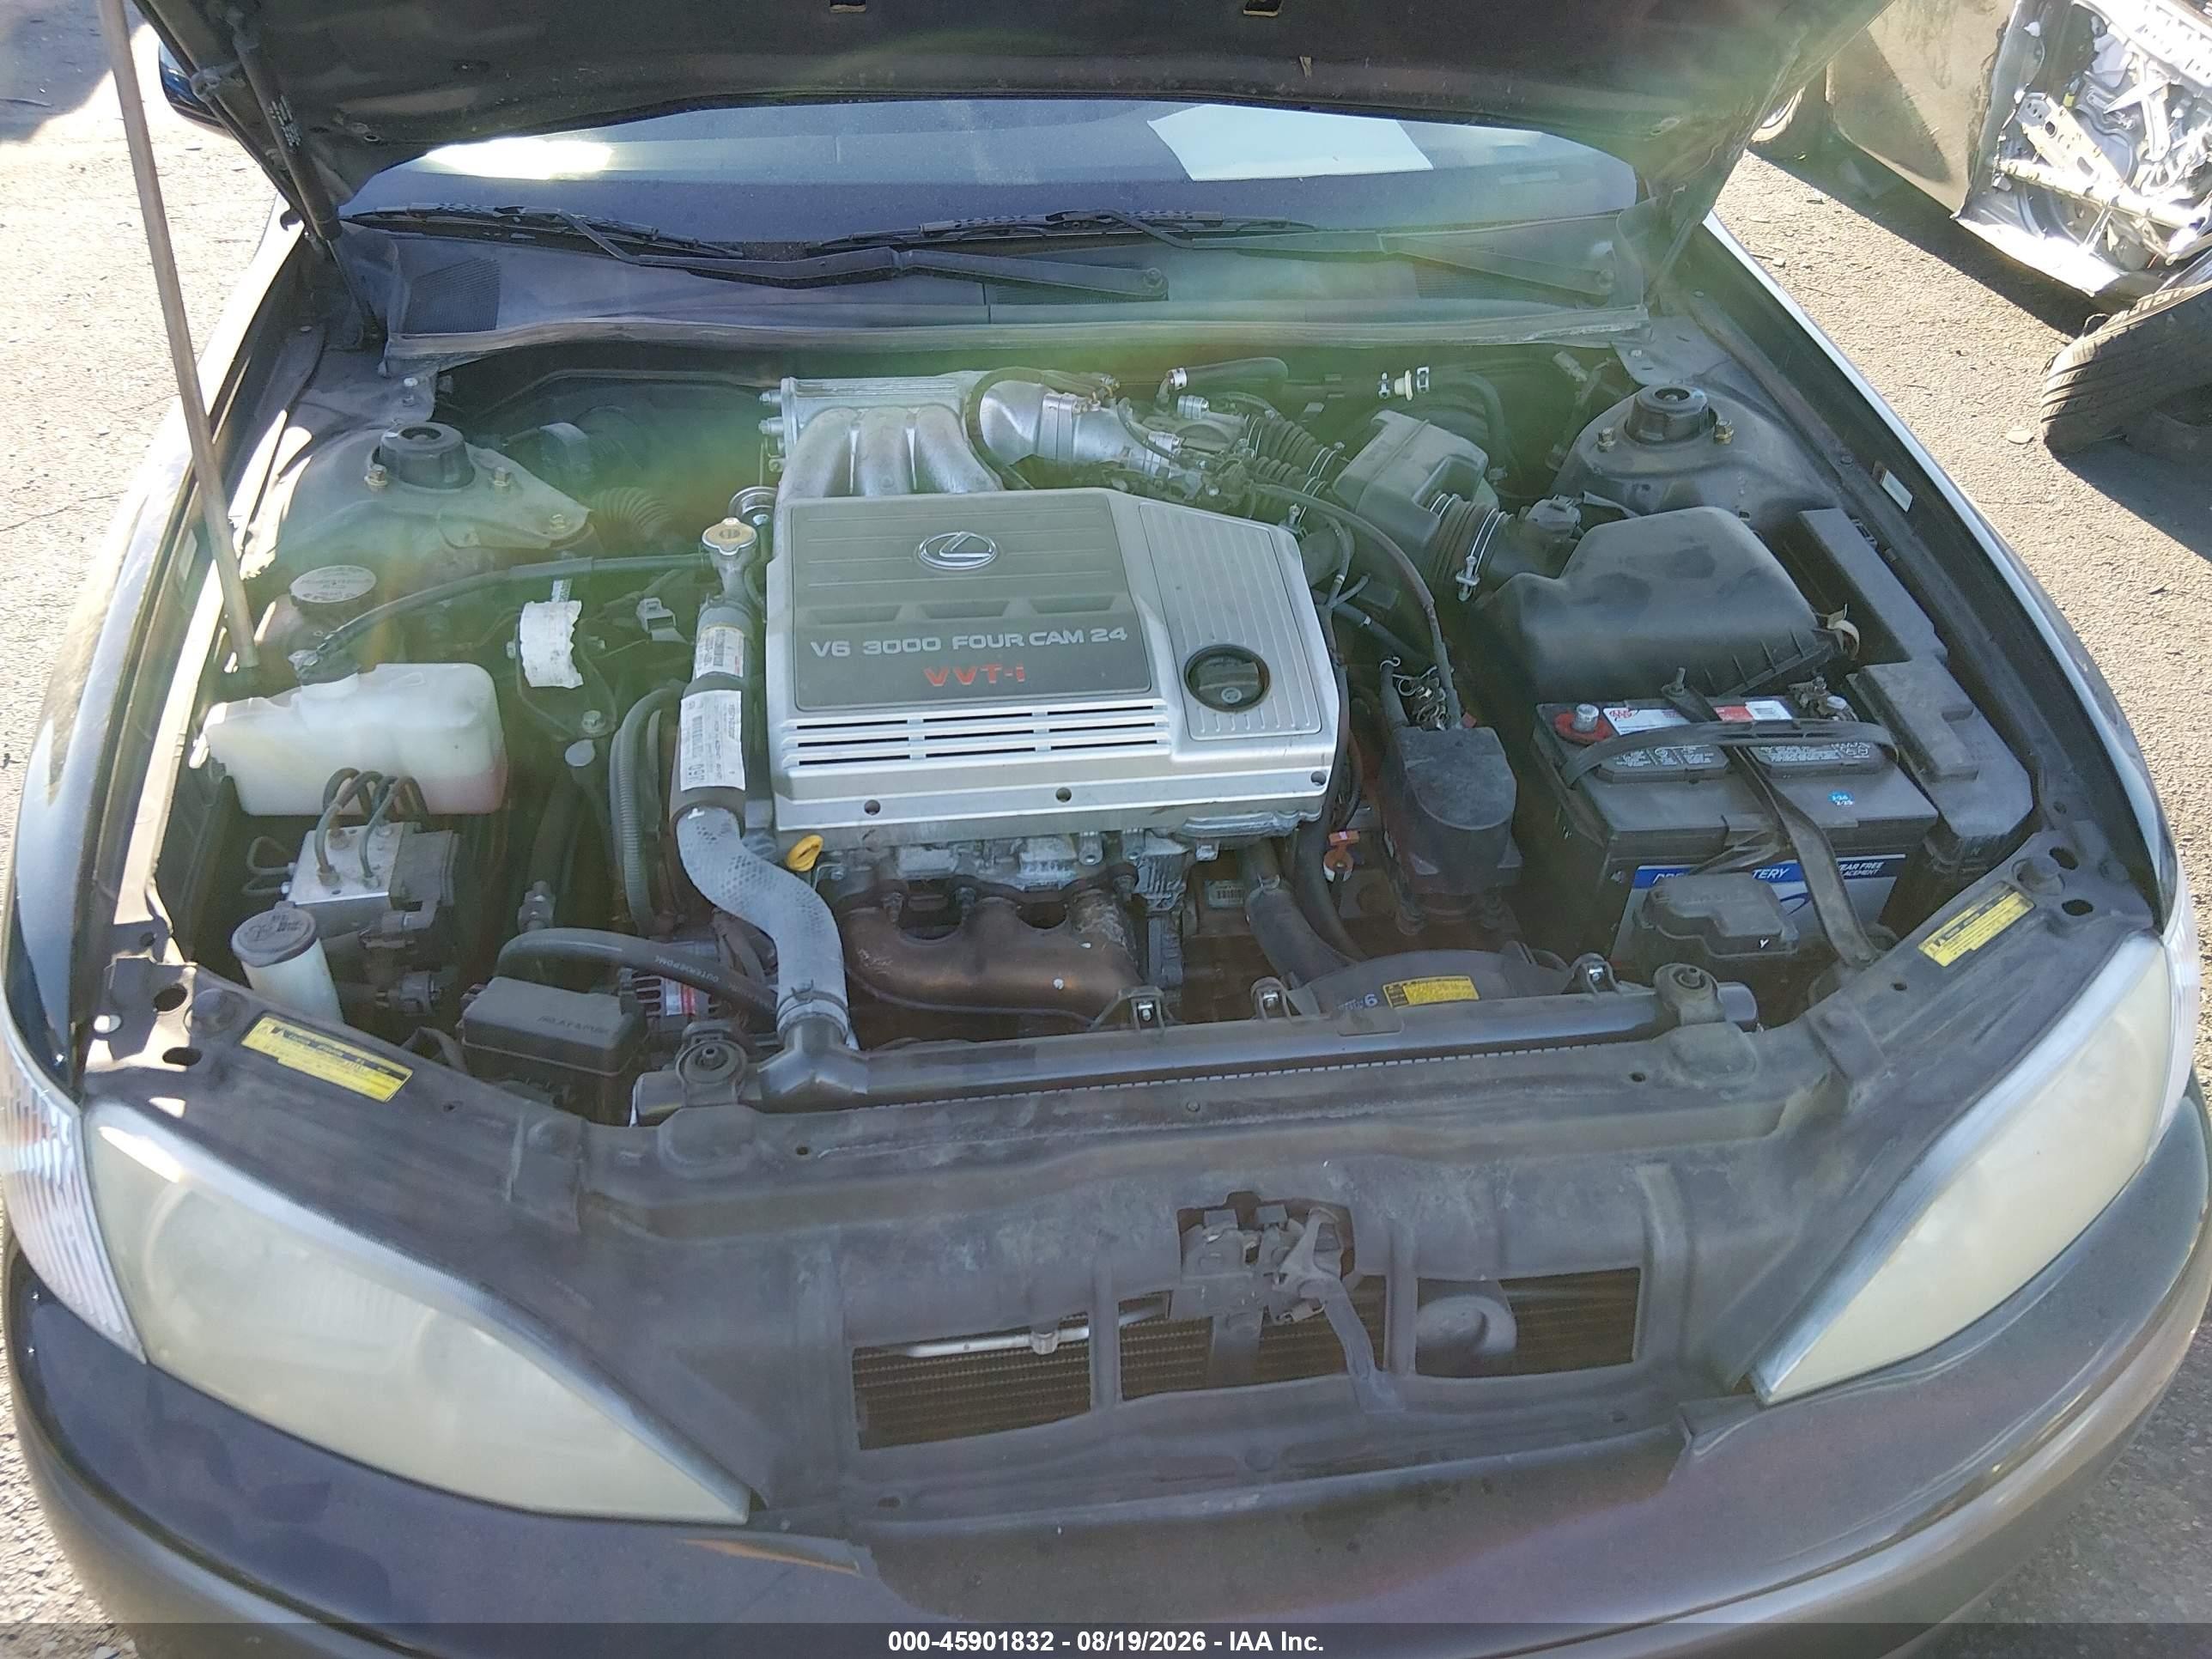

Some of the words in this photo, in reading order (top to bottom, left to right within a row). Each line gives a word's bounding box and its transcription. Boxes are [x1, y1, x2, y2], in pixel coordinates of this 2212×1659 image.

[811, 640, 851, 657] V6
[863, 636, 942, 655] 3000
[952, 632, 1025, 650] FOUR
[1029, 629, 1085, 646] CAM
[1091, 628, 1128, 642] 24
[1752, 867, 1790, 879] TERY
